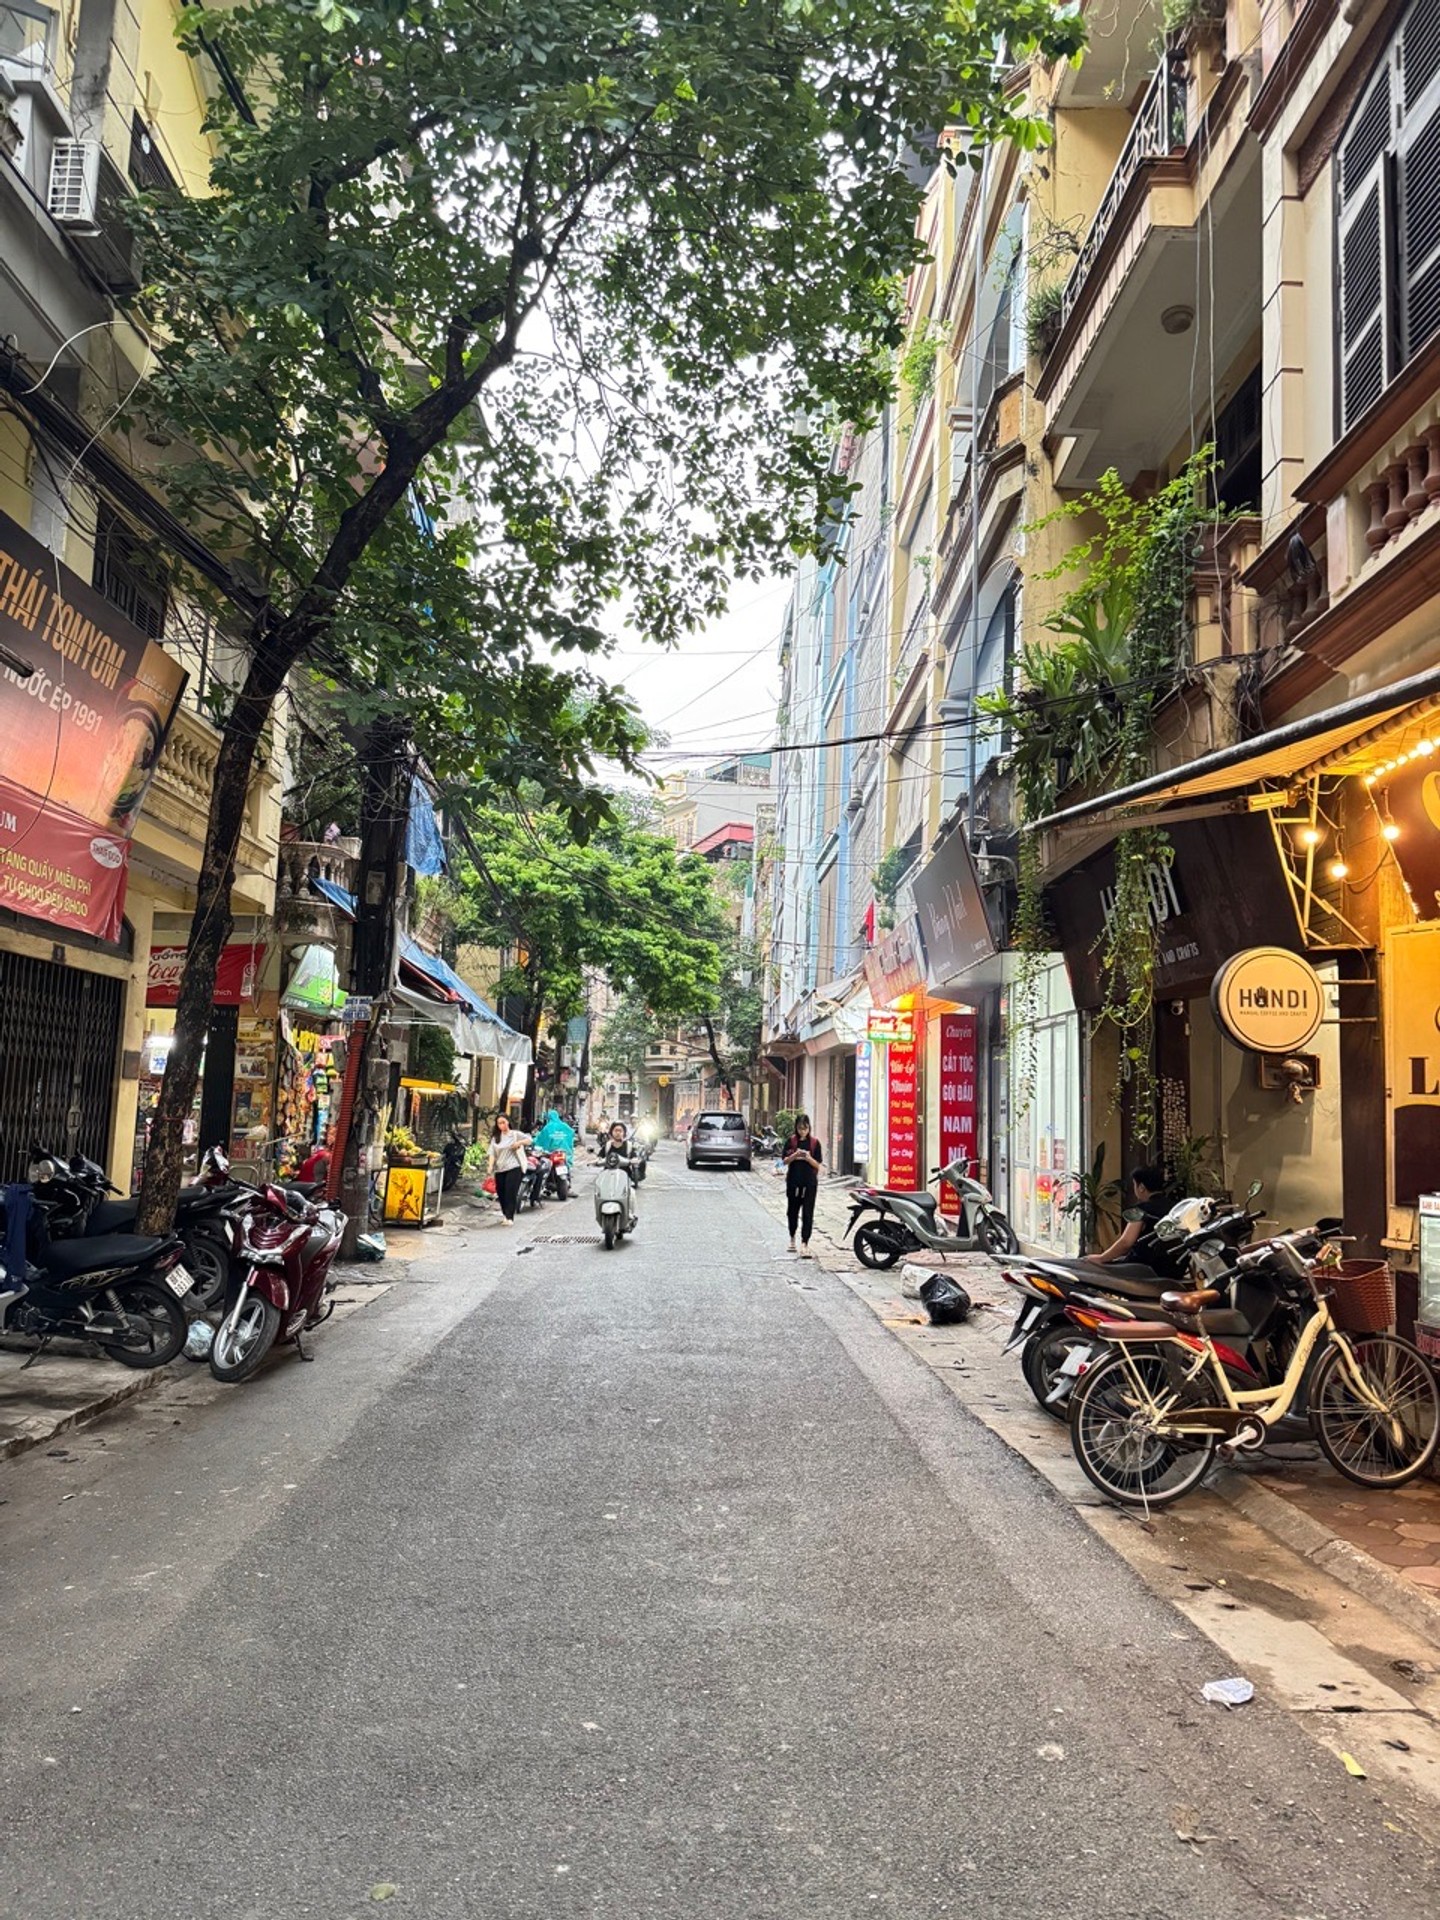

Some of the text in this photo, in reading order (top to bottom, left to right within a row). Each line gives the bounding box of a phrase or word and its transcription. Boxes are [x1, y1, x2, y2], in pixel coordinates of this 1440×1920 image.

[42, 592, 127, 690] TOMYOM
[72, 700, 103, 736] 1991
[1100, 855, 1181, 944] HDI
[946, 1025, 972, 1040] Chuyên
[959, 1052, 973, 1072] TÓC
[943, 1115, 973, 1133] NAM
